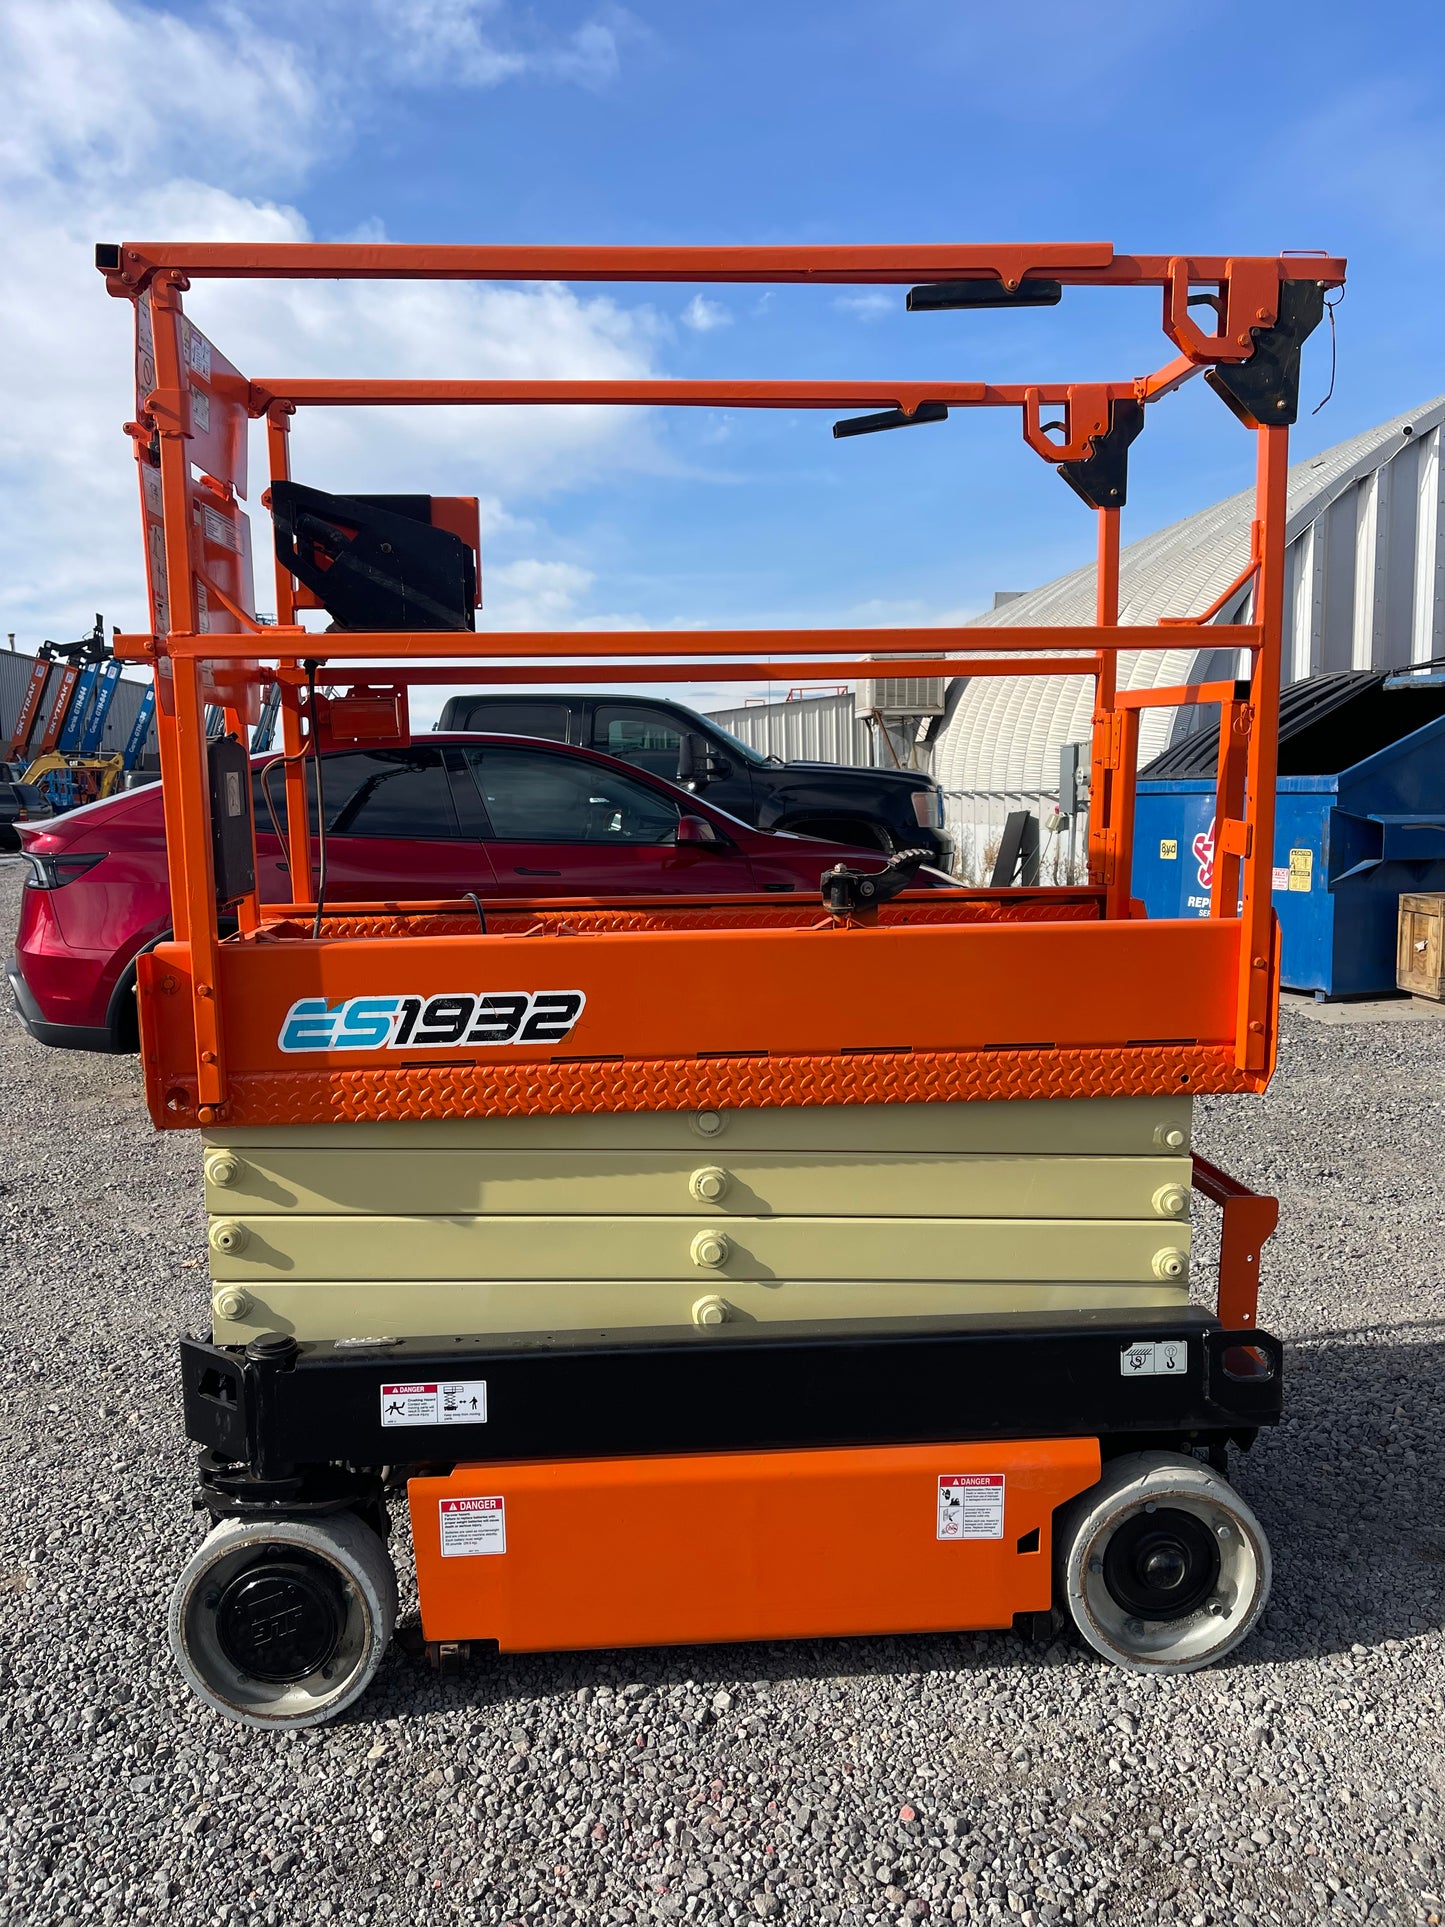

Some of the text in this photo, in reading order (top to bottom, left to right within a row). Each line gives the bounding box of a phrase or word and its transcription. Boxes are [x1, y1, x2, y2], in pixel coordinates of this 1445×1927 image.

[16, 681, 37, 736] SKYTRAK
[48, 684, 69, 736] SKYTRAK
[280, 990, 585, 1051] ES1932
[460, 1500, 497, 1510] DANGER
[960, 1478, 991, 1486] DANGER
